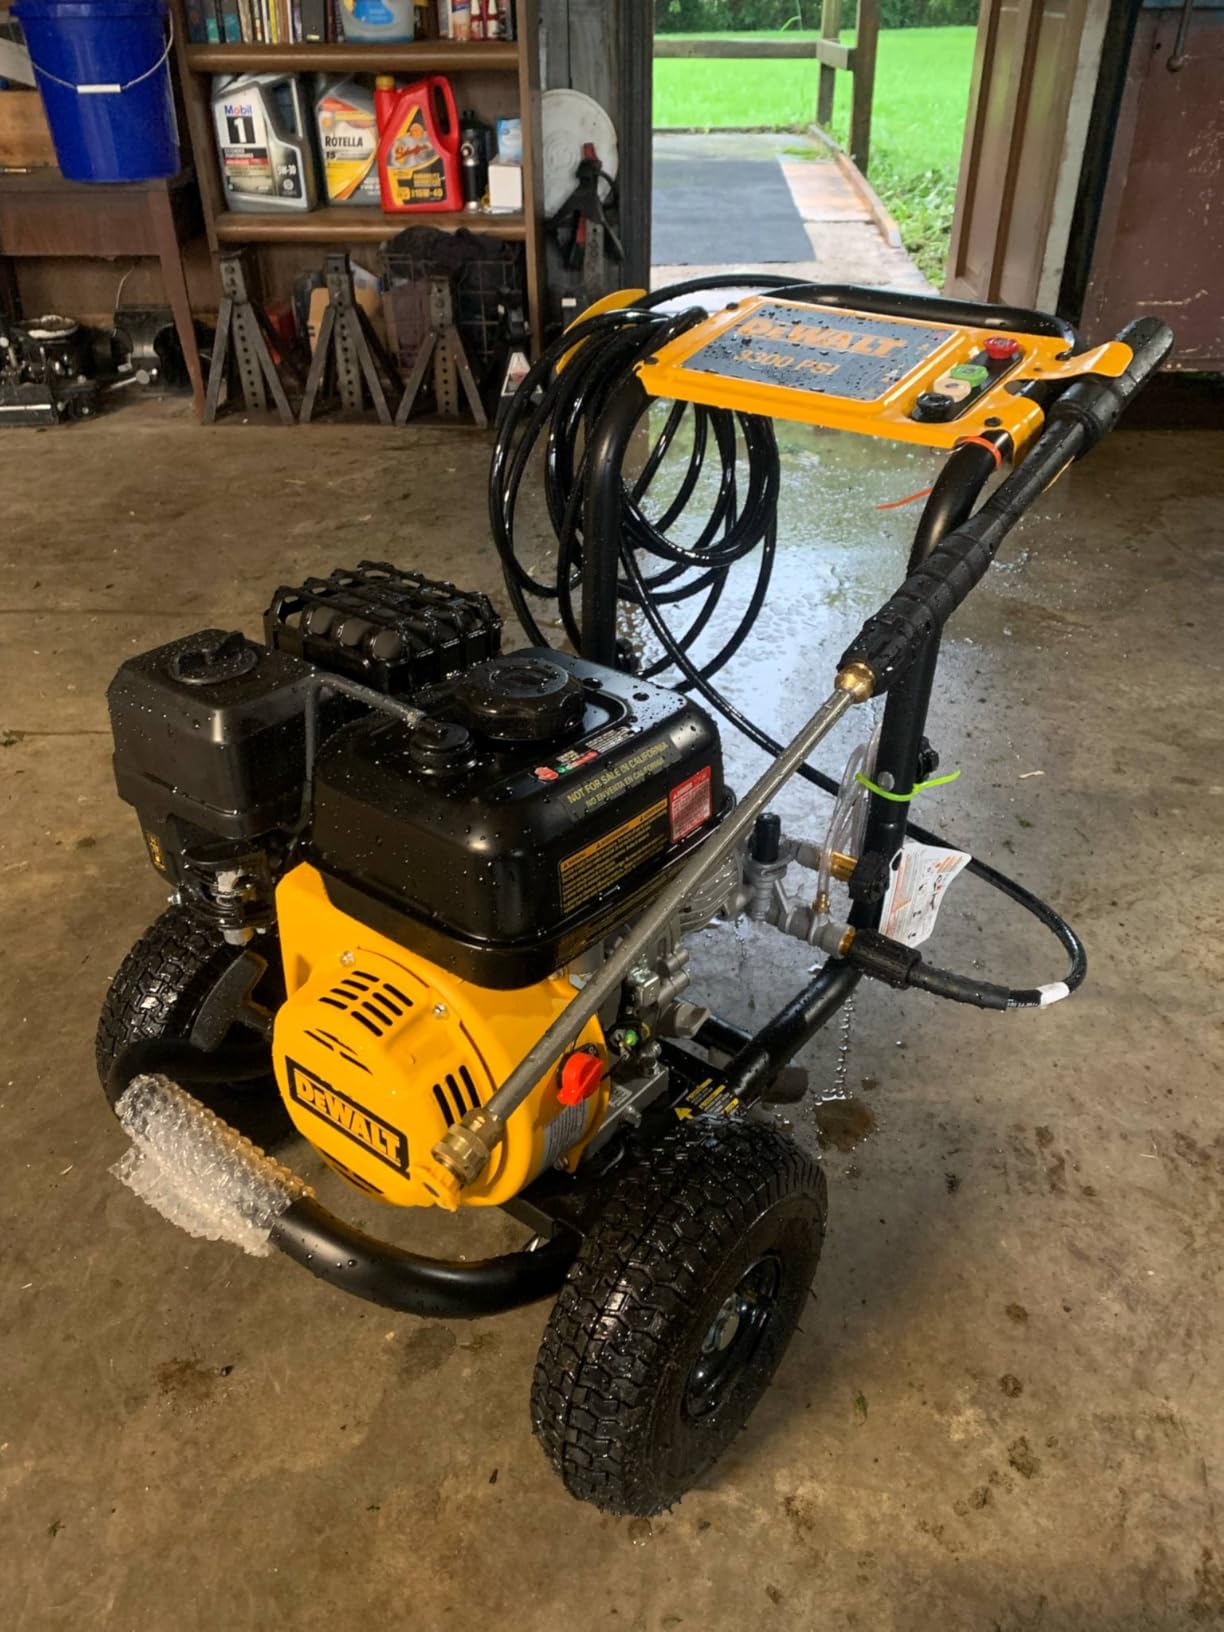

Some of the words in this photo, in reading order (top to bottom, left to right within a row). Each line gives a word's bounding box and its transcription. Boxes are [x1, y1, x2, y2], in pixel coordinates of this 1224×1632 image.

[224, 104, 252, 115] Mobil
[233, 117, 247, 143] 1
[325, 136, 363, 147] ROTELLA
[795, 358, 841, 376] PSI
[567, 787, 586, 804] NOT
[584, 778, 602, 794] FOR
[600, 766, 622, 785] SALE
[620, 763, 630, 774] IN
[628, 742, 668, 769] CALIFORNIA
[586, 797, 597, 808] NO
[293, 1067, 402, 1167] DEWALT
